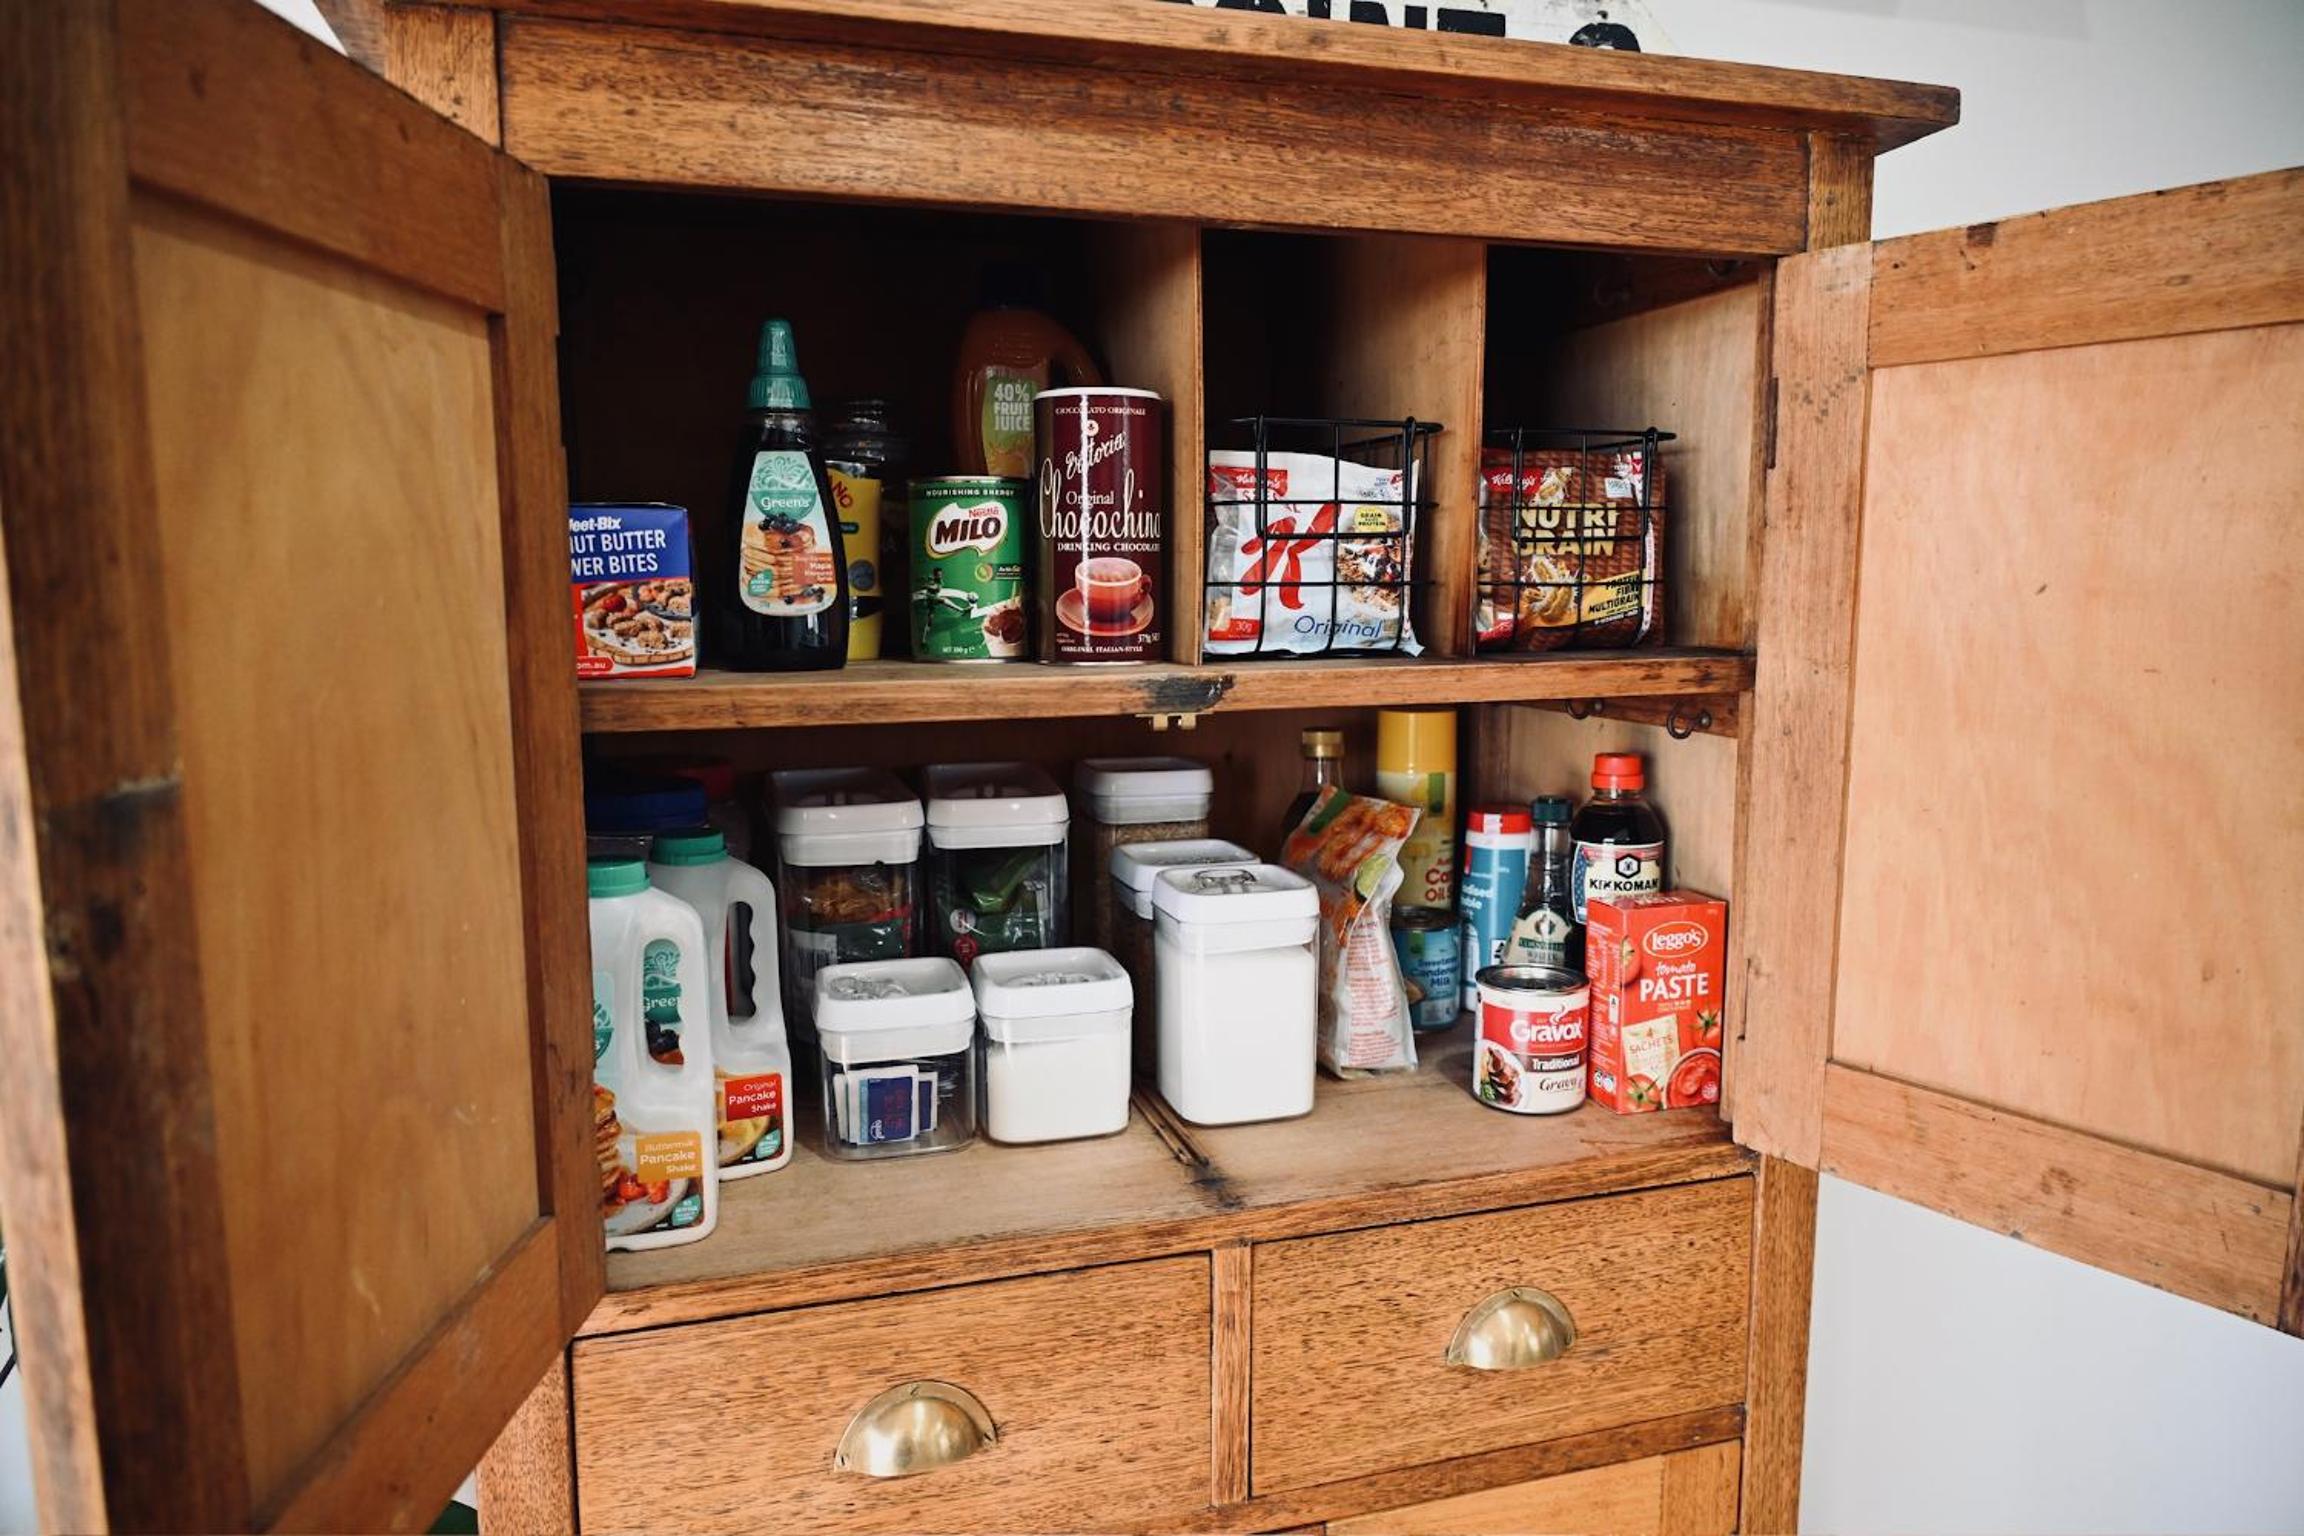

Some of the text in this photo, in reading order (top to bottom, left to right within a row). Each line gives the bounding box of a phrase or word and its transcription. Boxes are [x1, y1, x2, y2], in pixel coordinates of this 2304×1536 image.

[994, 384, 1030, 401] 40%
[994, 402, 1030, 415] FRUIT
[994, 416, 1031, 431] JUICE
[982, 487, 1015, 496] ENERGY
[1066, 490, 1115, 509] Orginal
[935, 517, 1001, 545] MILO
[601, 529, 667, 552] BUTTER
[608, 552, 659, 574] BITES
[1589, 879, 1659, 892] KIKKOMAN
[1640, 973, 1709, 1002] PASTE
[1510, 1017, 1583, 1042] Gravox
[728, 1090, 777, 1105] Pancake
[751, 1102, 777, 1113] Shake
[640, 1151, 696, 1165] Pancake
